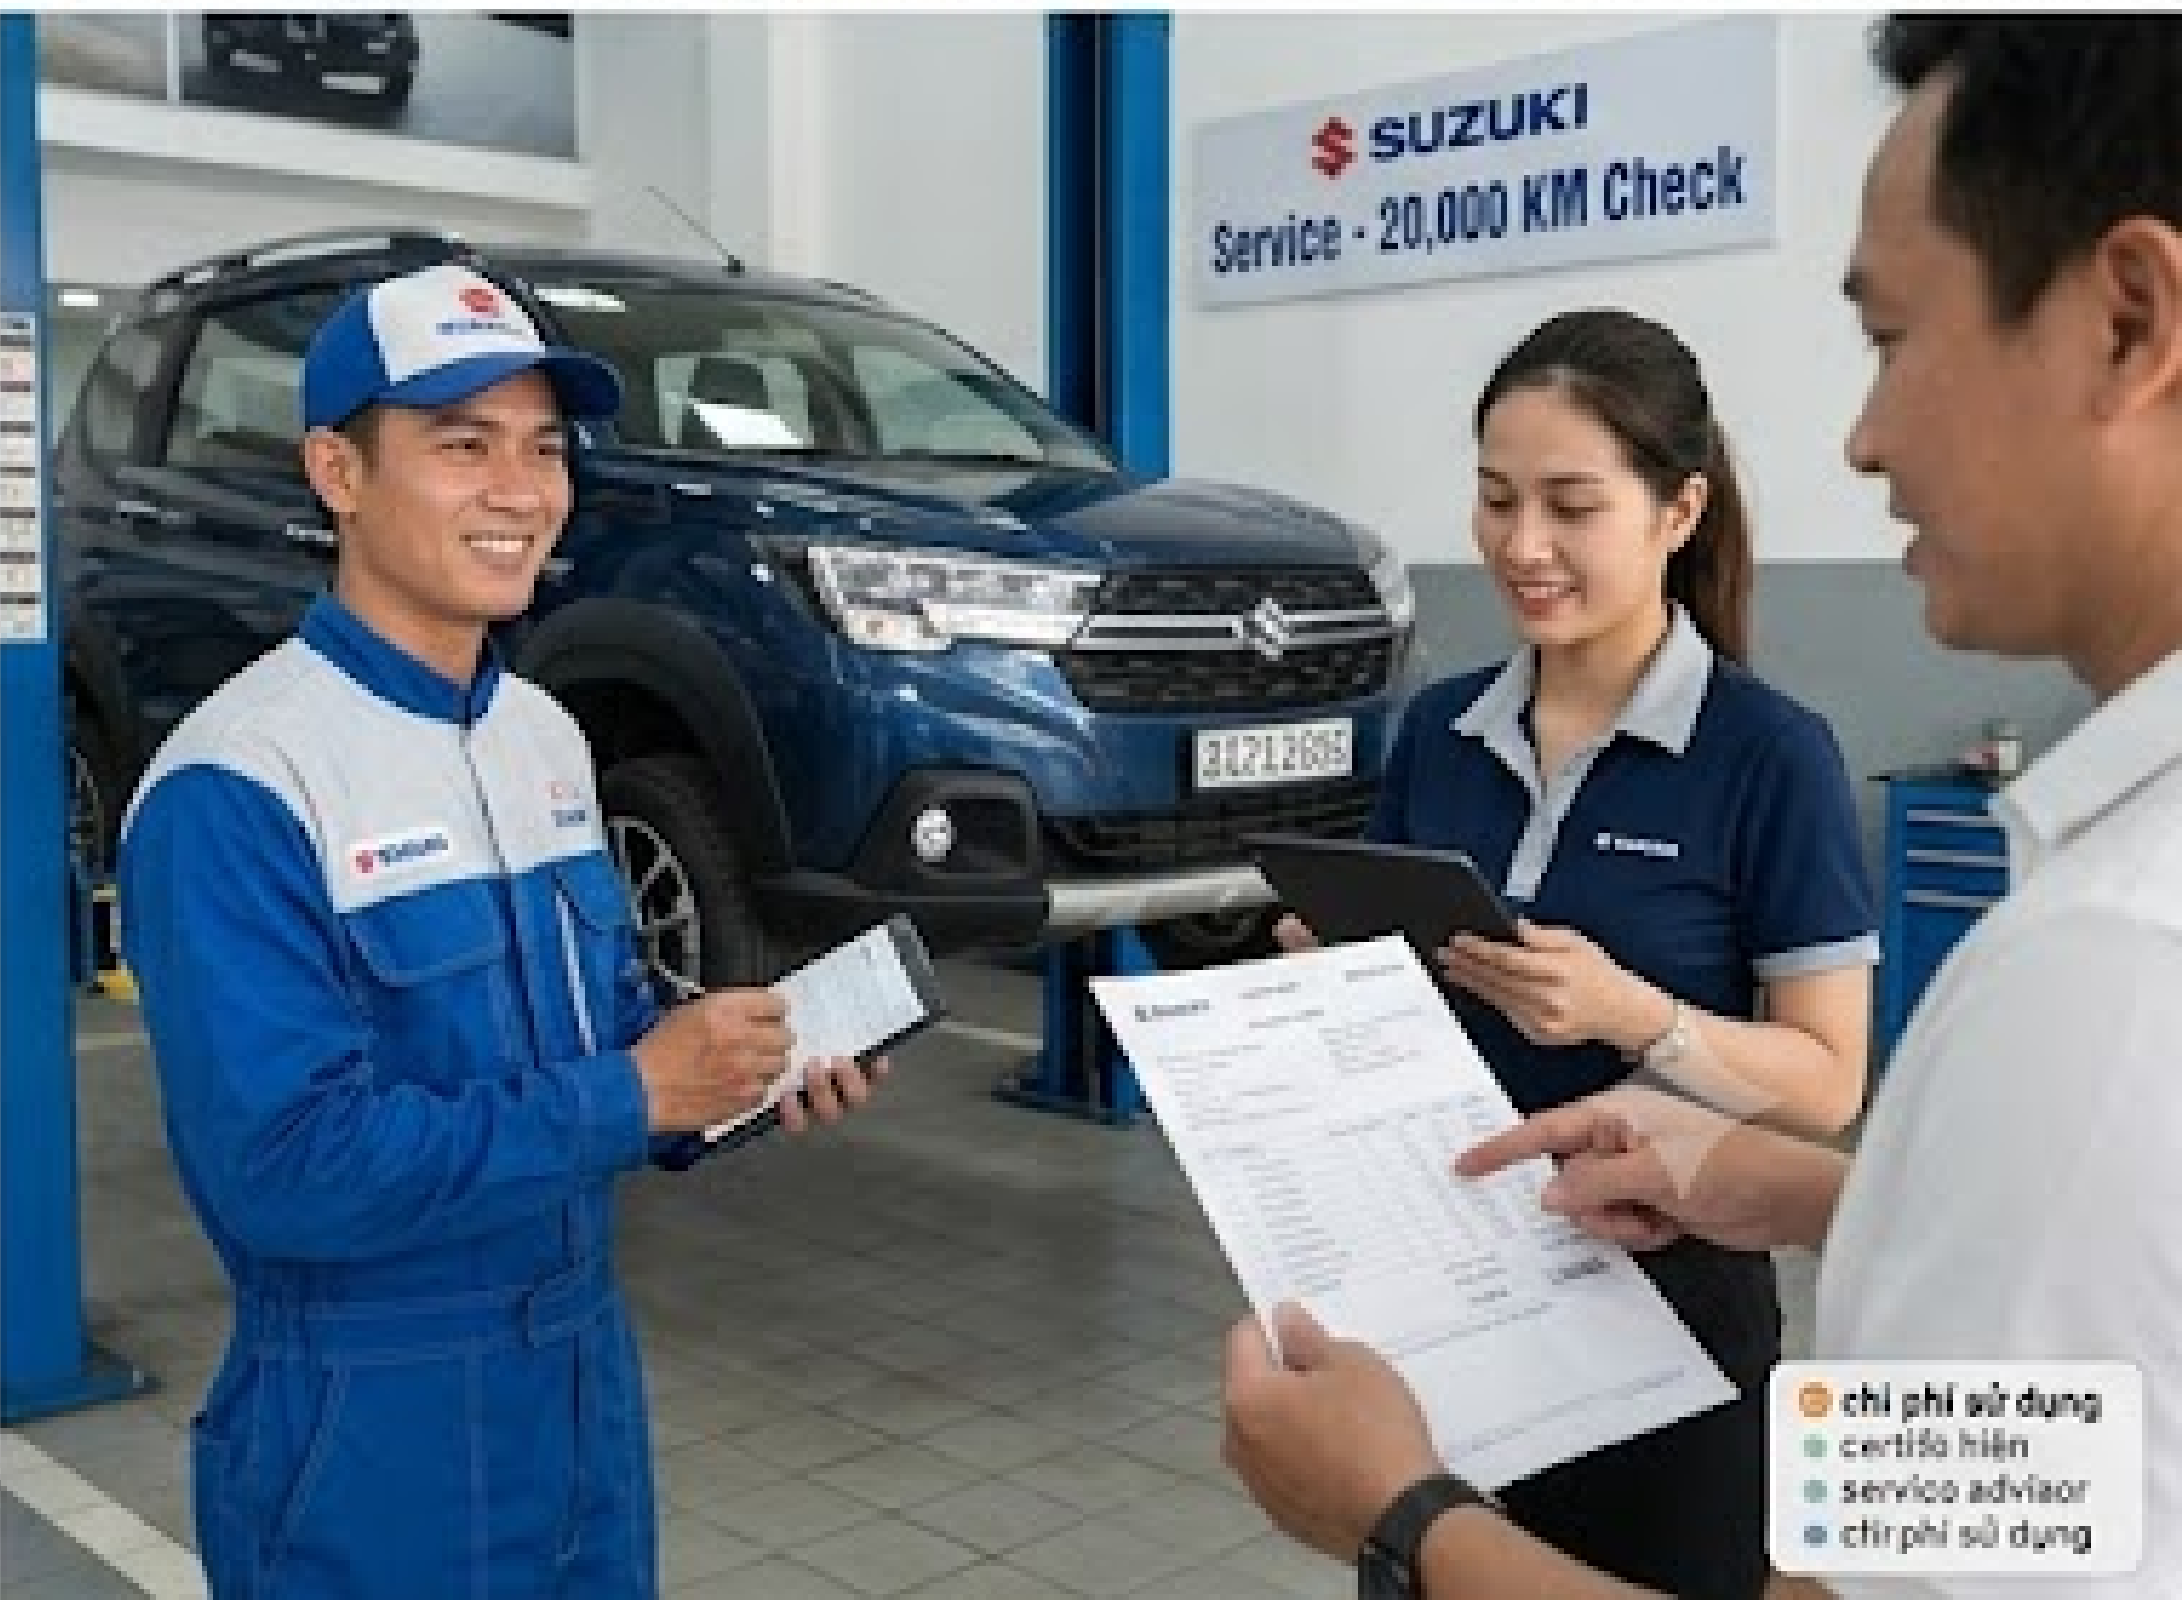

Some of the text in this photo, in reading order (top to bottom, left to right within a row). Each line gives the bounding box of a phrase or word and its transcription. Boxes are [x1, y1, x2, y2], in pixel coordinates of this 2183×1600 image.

[1368, 82, 1588, 162] SUZUKI
[1210, 211, 1341, 276] Service
[1376, 180, 1507, 254] 20,000
[1523, 168, 1588, 232] KM
[1603, 146, 1747, 220] Check
